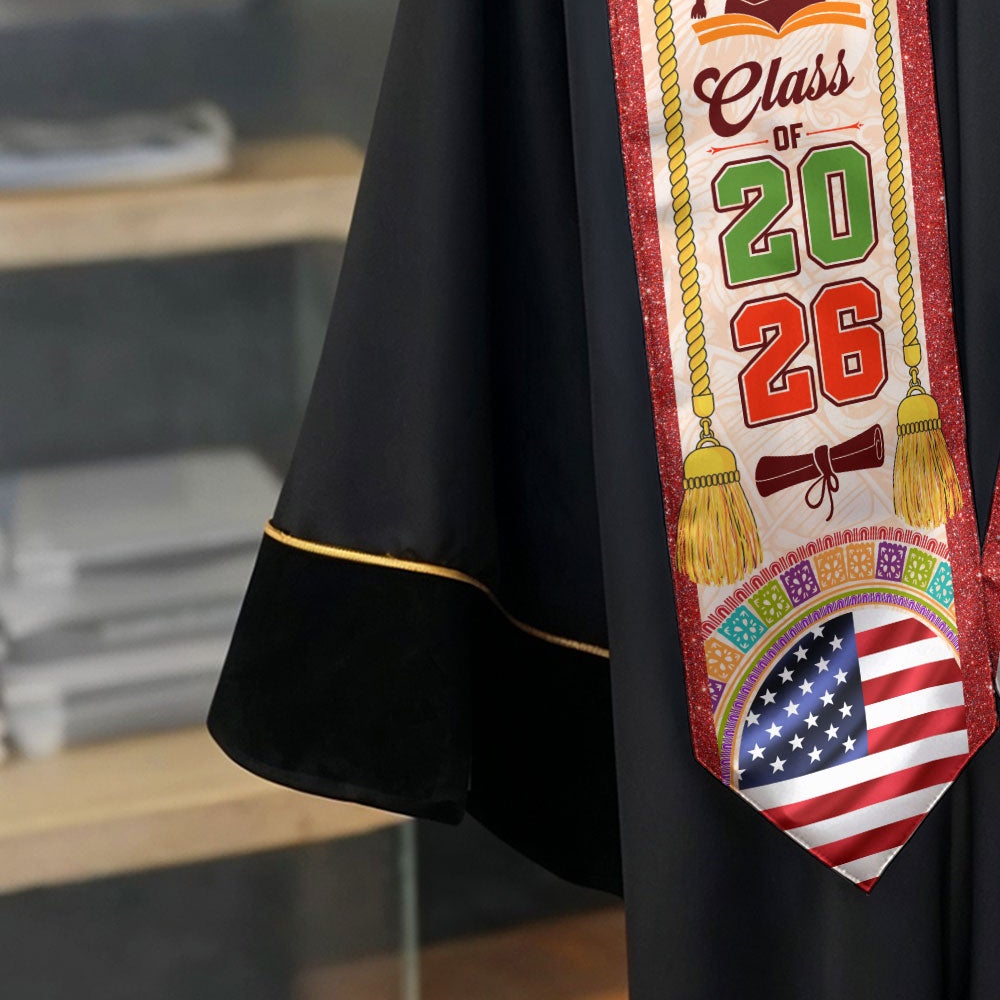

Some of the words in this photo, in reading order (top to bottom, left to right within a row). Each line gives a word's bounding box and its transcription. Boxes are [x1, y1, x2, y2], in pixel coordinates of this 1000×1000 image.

[693, 48, 855, 138] Class
[773, 123, 803, 151] OF
[711, 141, 879, 289] 20
[732, 277, 888, 428] 26
